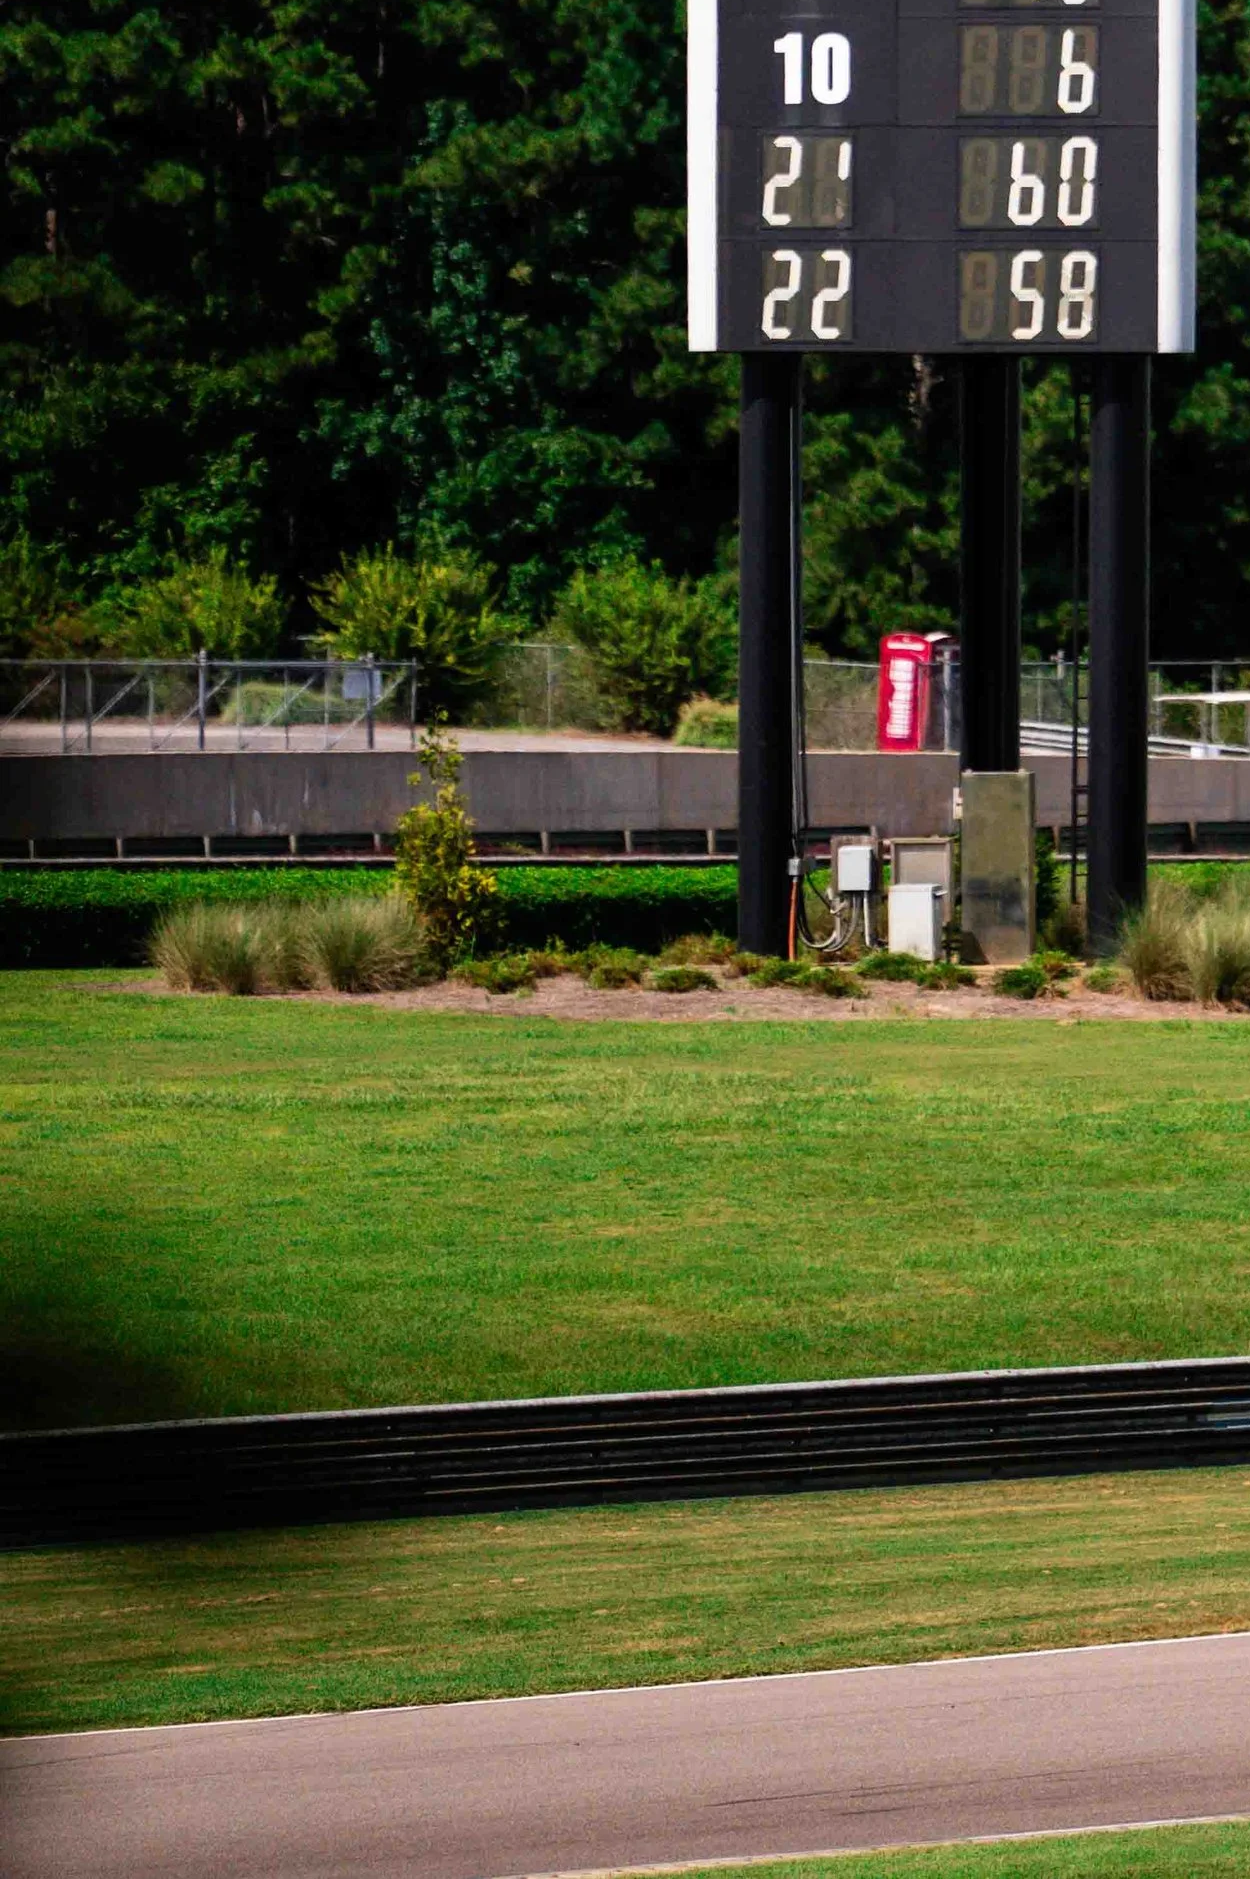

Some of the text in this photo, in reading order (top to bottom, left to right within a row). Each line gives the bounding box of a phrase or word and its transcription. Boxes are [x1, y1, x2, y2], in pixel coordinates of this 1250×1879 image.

[774, 33, 850, 104] 10
[762, 250, 1097, 339] 22 58
